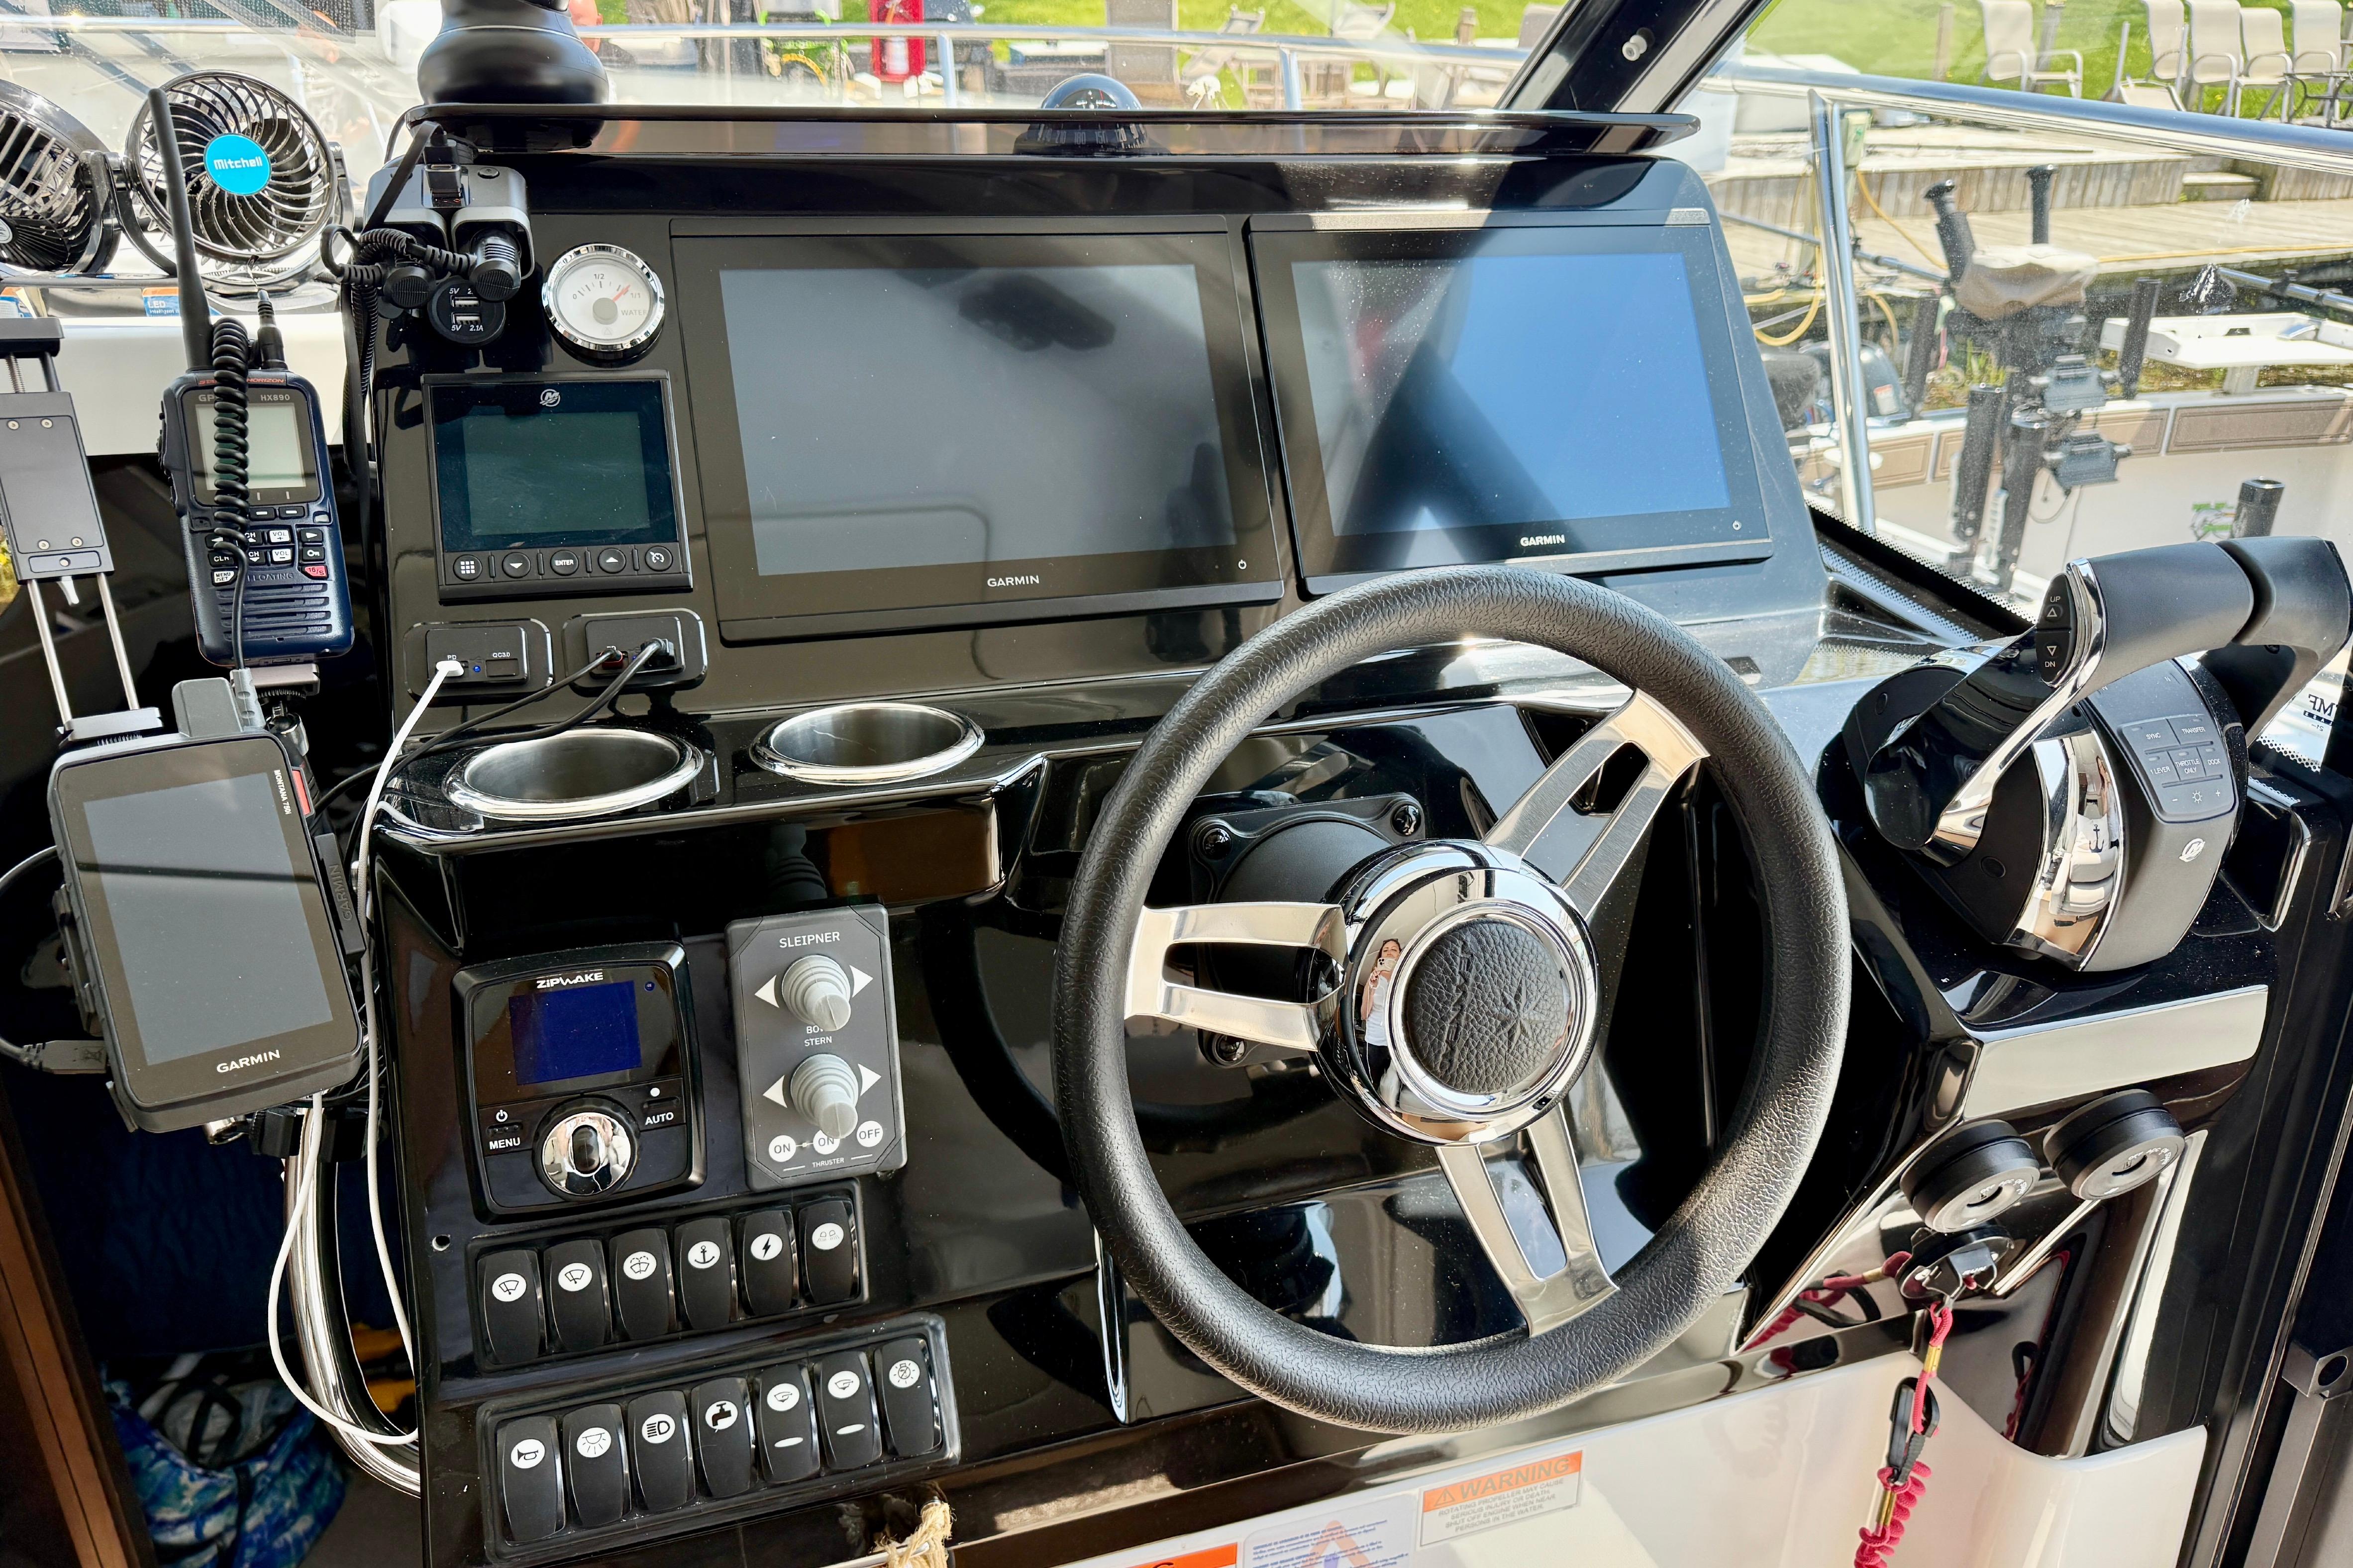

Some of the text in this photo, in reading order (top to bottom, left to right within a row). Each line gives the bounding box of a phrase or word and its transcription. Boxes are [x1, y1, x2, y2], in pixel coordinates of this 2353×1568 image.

[1074, 132, 1086, 145] 180
[1520, 534, 1565, 546] GARMIN
[987, 575, 1039, 587] GARMIN
[2175, 759, 2200, 768] THROTTLE
[274, 770, 288, 801] MONTANA
[328, 864, 353, 921] GARMIN
[779, 931, 840, 948] SLEIPNER
[806, 1025, 823, 1034] BO
[804, 1036, 832, 1047] STERN
[216, 1049, 280, 1073] GARMIN
[645, 1112, 674, 1126] AUTO
[859, 1128, 880, 1140] OFF
[489, 1137, 520, 1150] MENU
[818, 1137, 834, 1146] ON
[774, 1143, 791, 1154] ON
[812, 1158, 844, 1168] THRUSTER
[1460, 1458, 1569, 1500] WARNING
[1438, 1478, 1564, 1516] ROTATING PROPELLER MAY CAUSE
[1445, 1494, 1556, 1528] SHUT OFF ENGINE WHEN NEAR
[1451, 1506, 1484, 1520] SERIOUS
[1485, 1499, 1512, 1511] INJURY
[1455, 1518, 1491, 1532] PERSONS
[1502, 1511, 1516, 1520] THE
